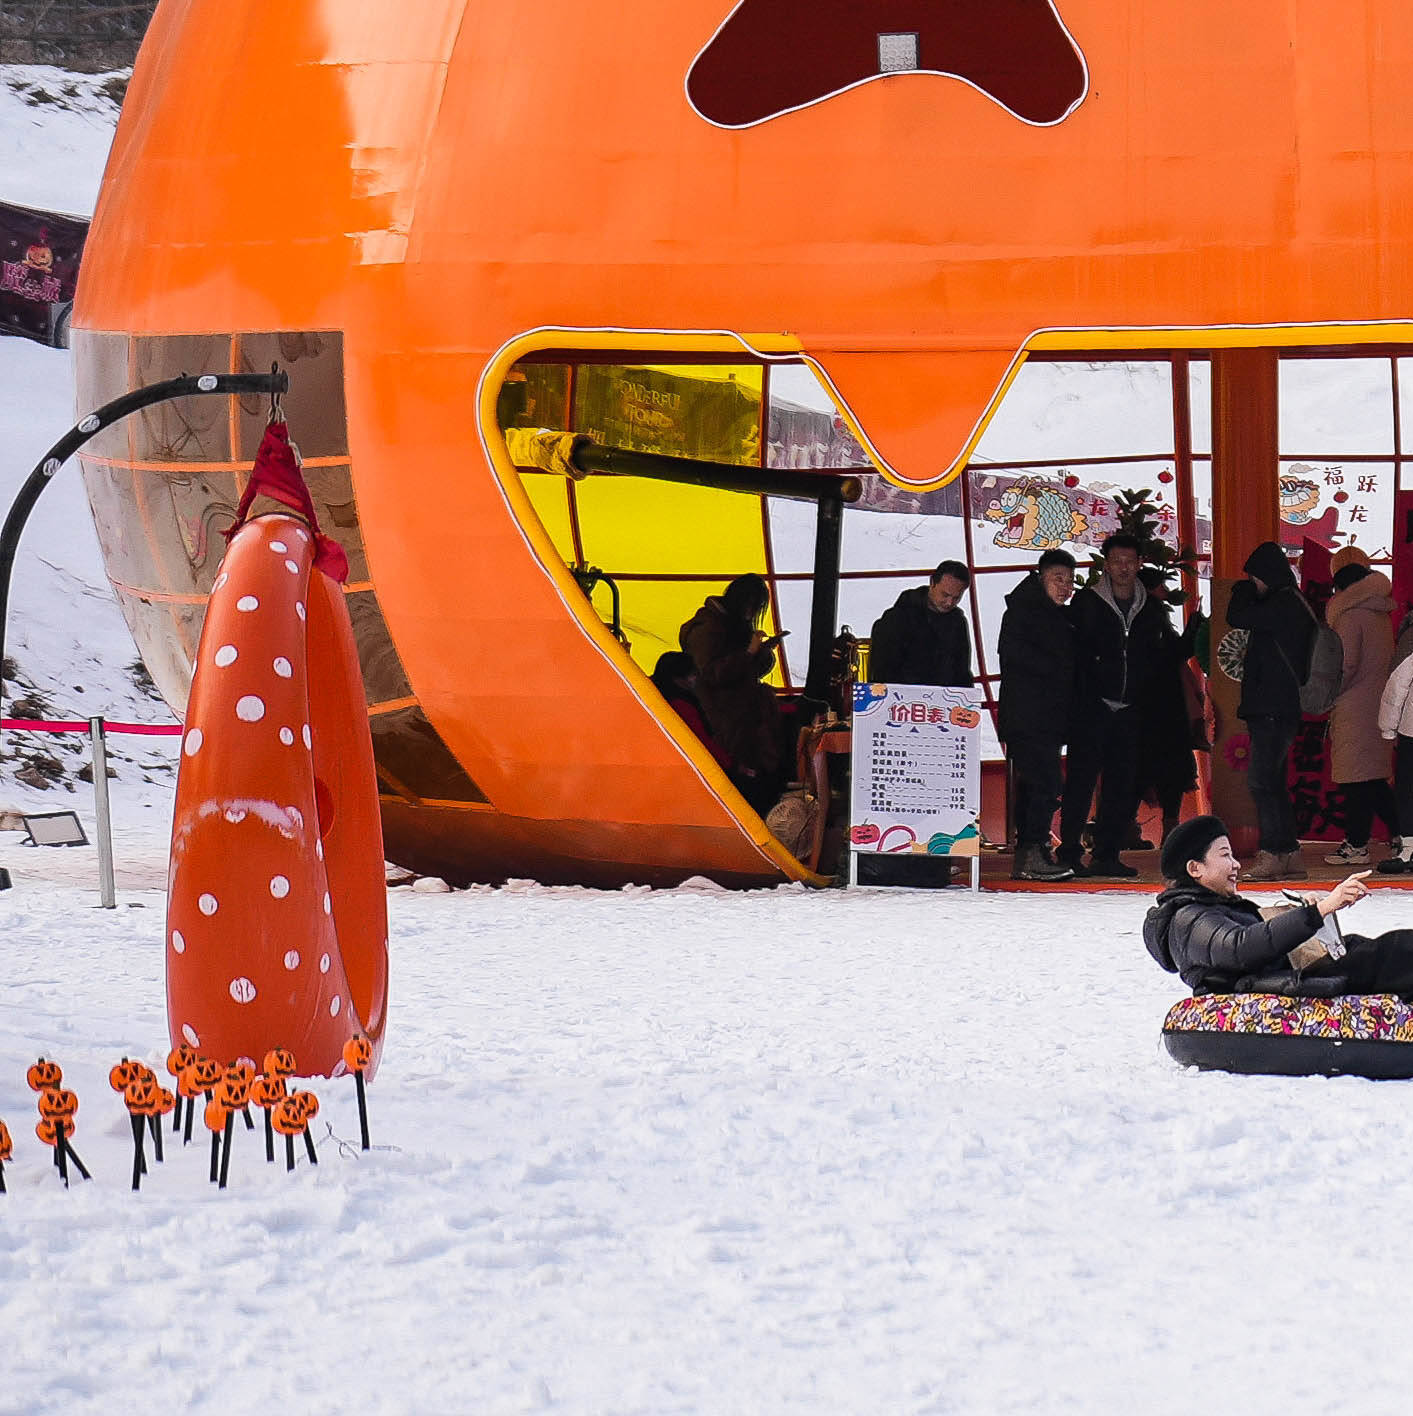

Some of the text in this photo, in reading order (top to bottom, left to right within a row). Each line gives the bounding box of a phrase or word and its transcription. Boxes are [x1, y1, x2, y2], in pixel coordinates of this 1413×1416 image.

[1323, 466, 1344, 486] 福
[1349, 504, 1369, 523] 龙
[888, 703, 945, 723] 价目表
